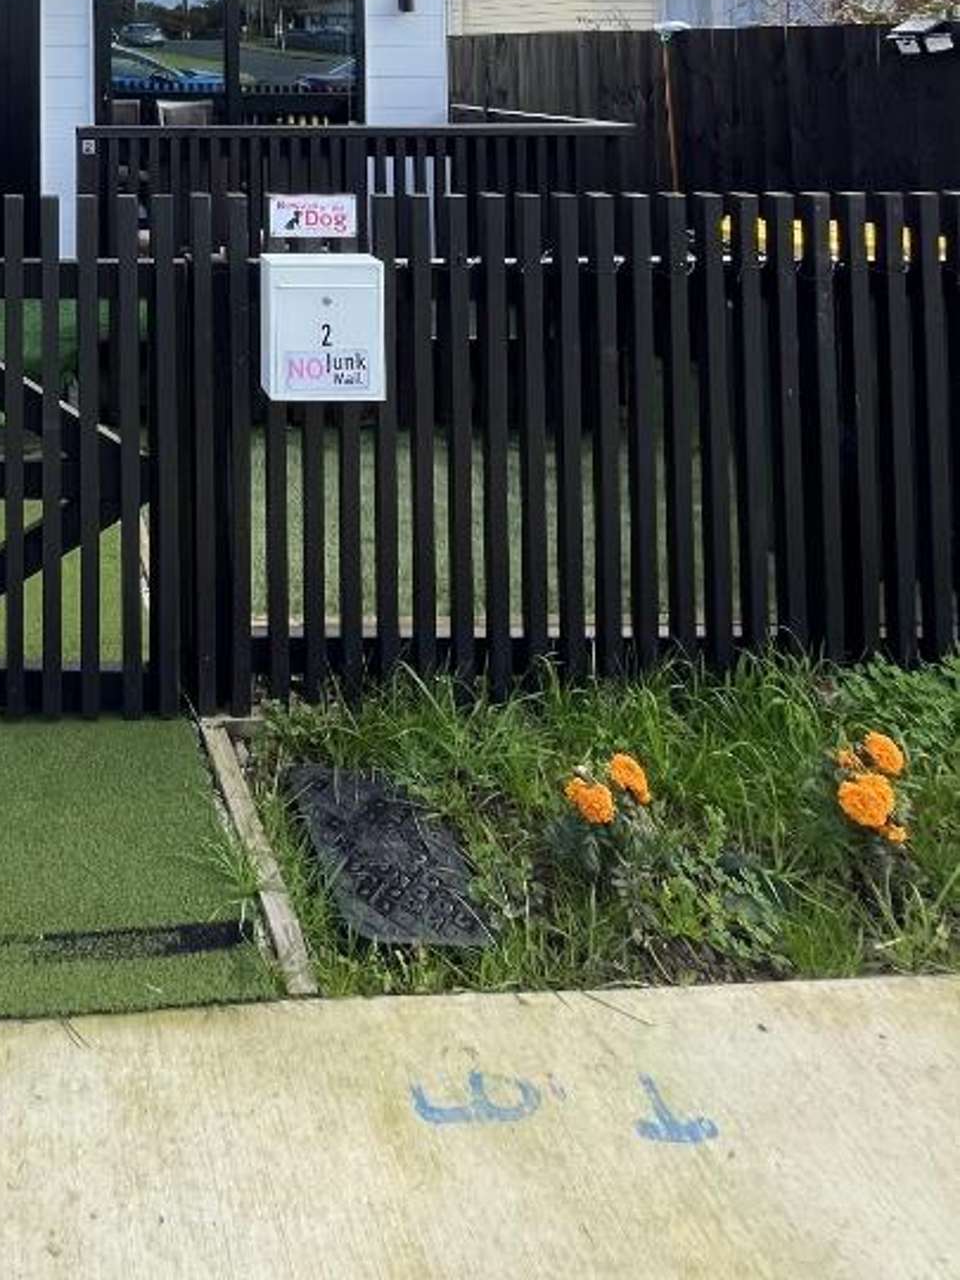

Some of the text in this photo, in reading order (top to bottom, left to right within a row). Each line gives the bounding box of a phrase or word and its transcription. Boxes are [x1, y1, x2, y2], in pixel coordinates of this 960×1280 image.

[305, 210, 347, 233] Dog
[321, 323, 333, 347] 2
[287, 352, 367, 380] NO Junk
